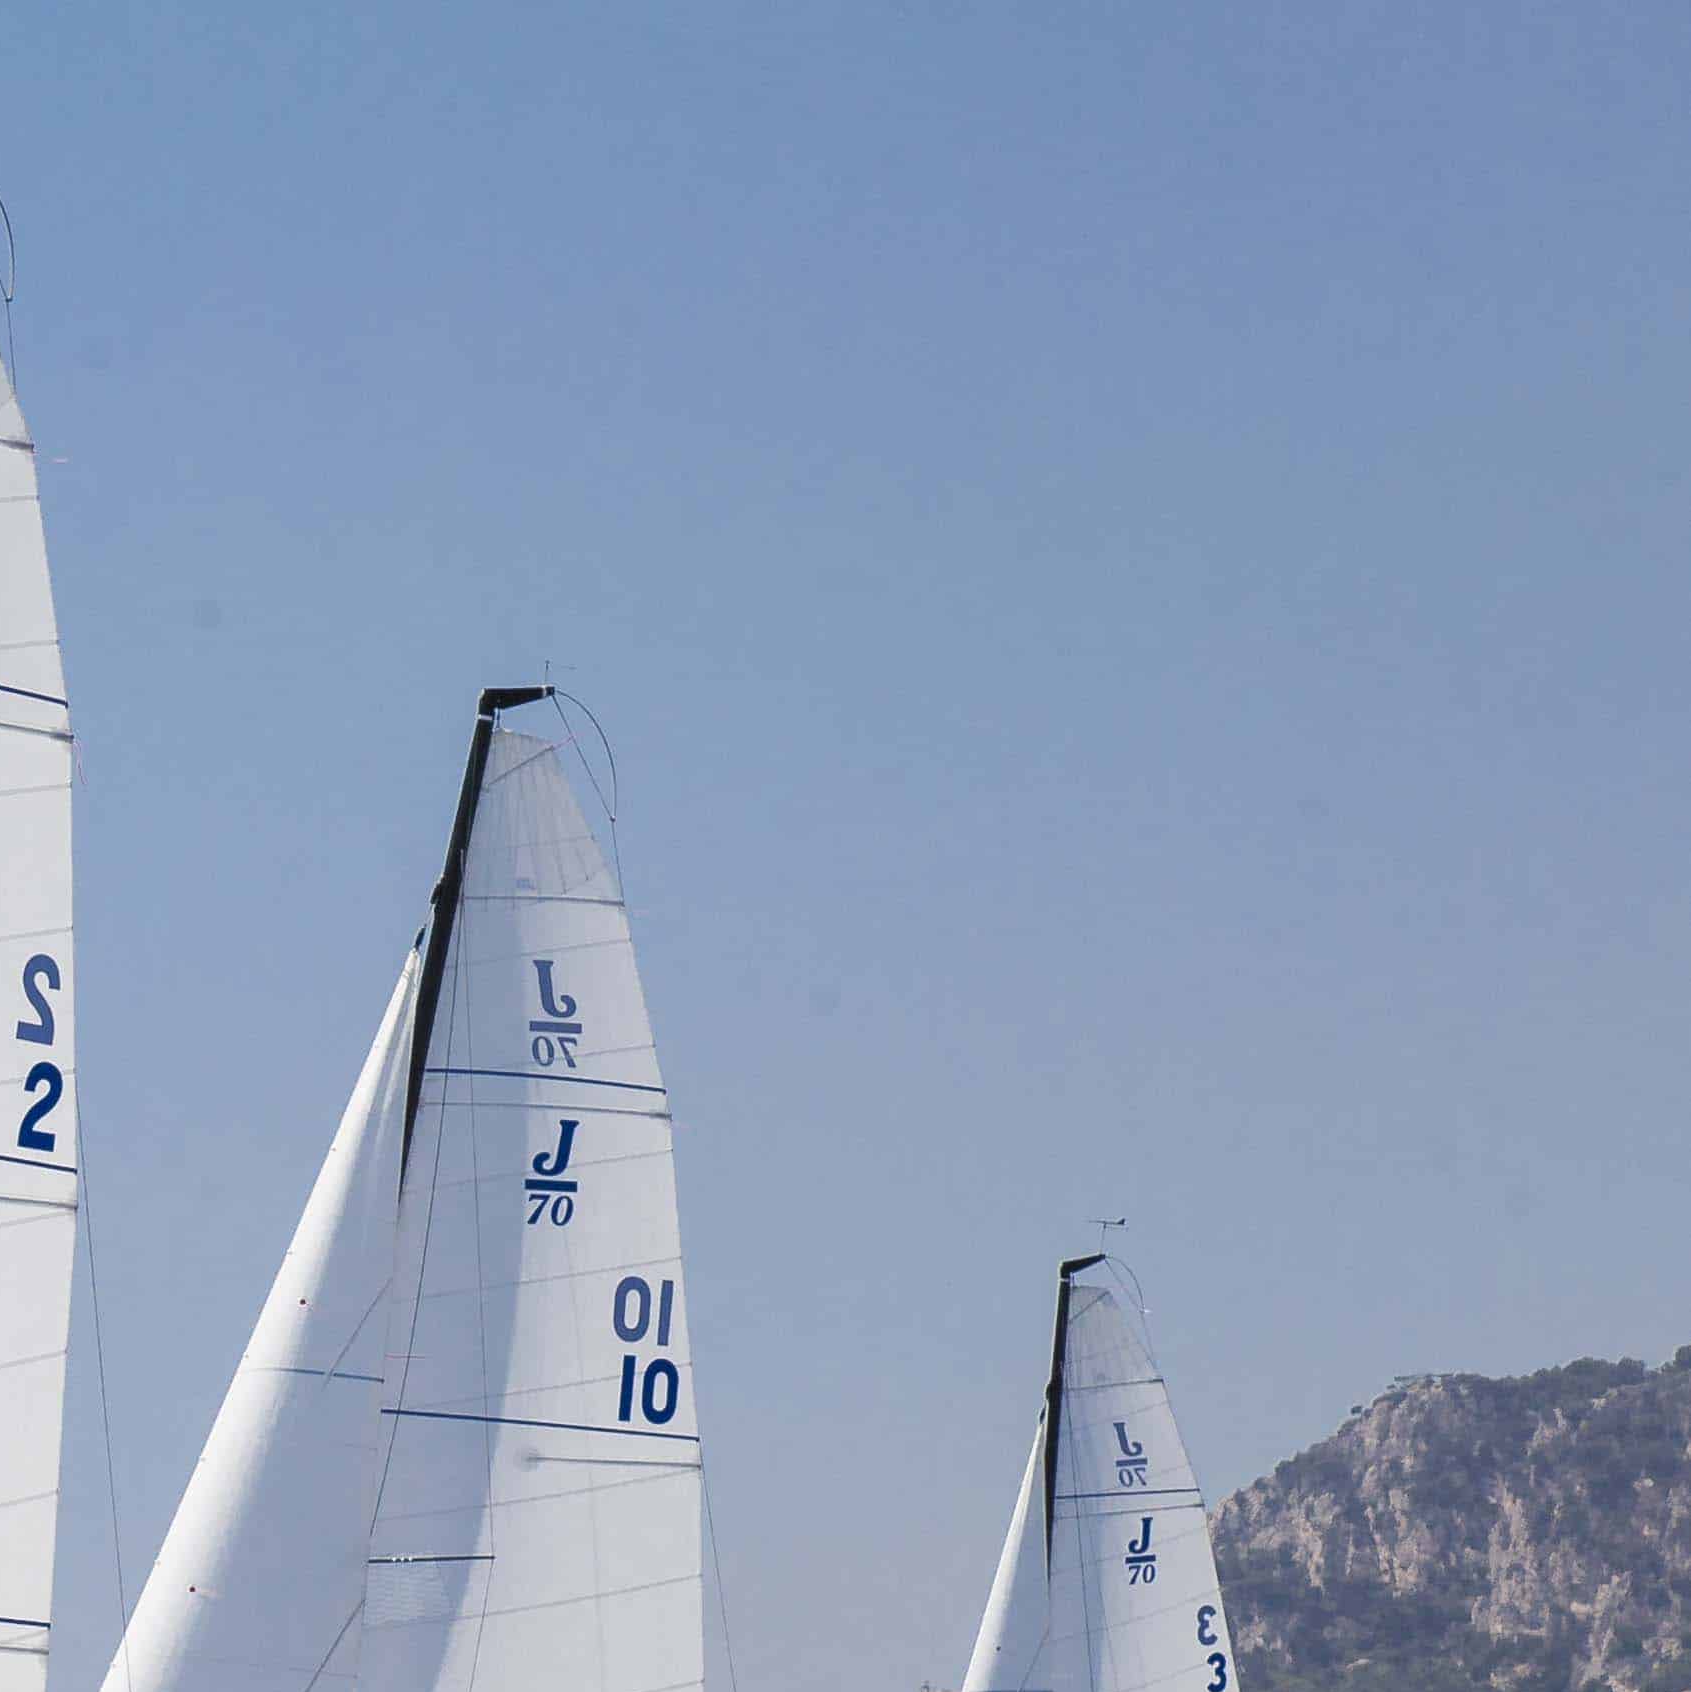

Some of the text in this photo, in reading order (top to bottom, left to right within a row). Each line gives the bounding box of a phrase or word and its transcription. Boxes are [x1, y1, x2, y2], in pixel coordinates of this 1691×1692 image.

[16, 1061, 63, 1153] 2
[532, 1119, 580, 1177] J
[527, 1193, 574, 1227] 70
[618, 1354, 679, 1425] 10
[1128, 1516, 1154, 1555] J
[1128, 1563, 1156, 1586] 70
